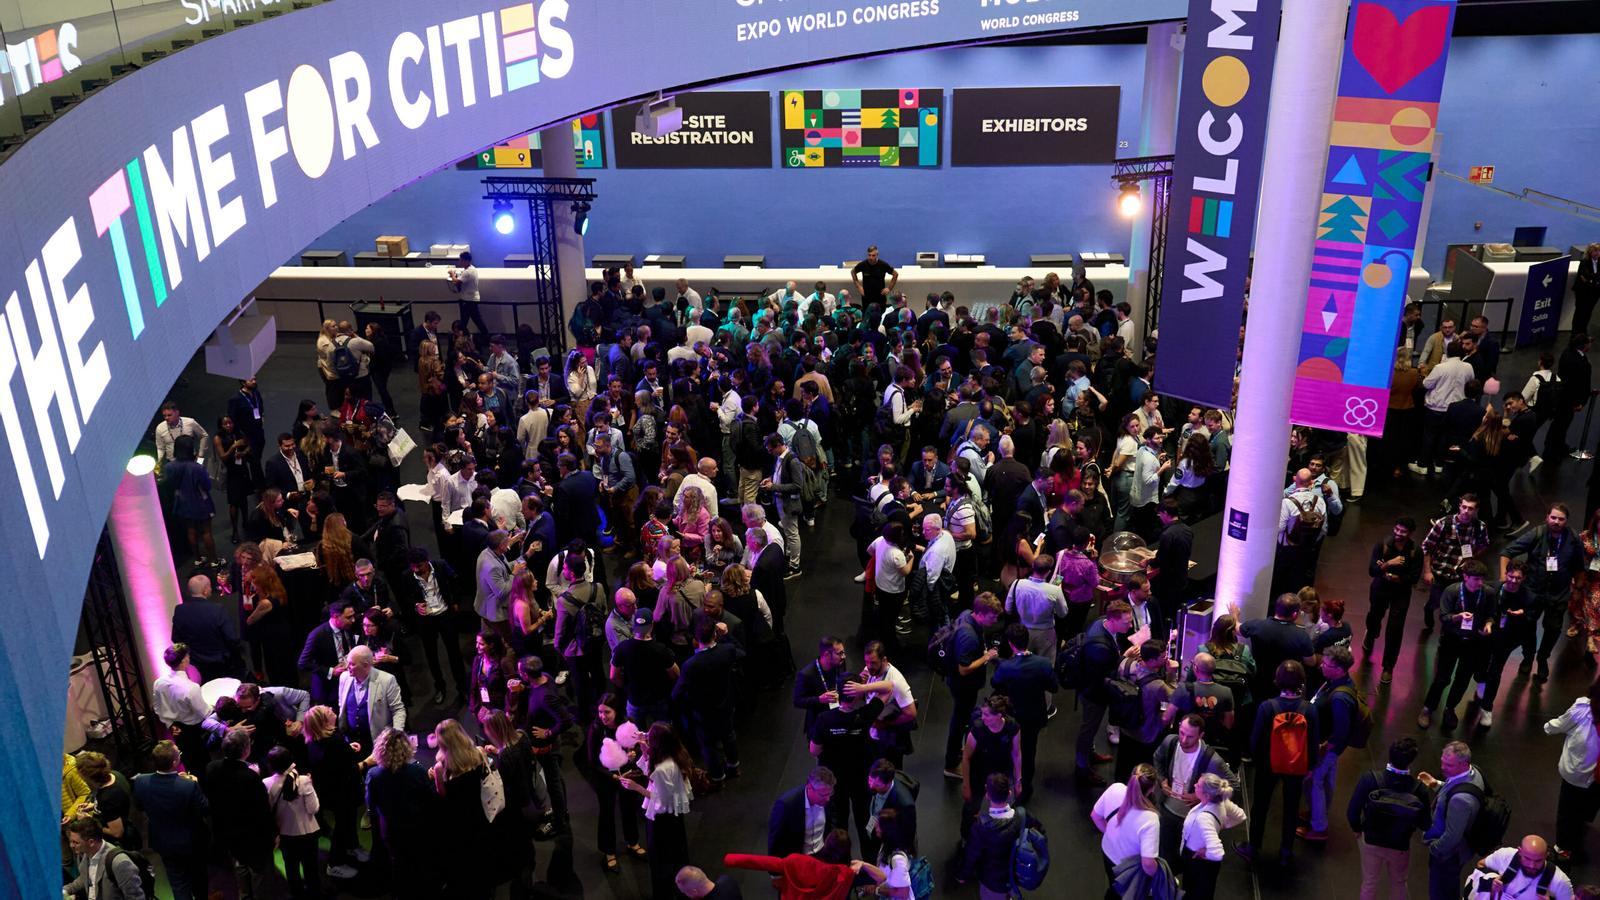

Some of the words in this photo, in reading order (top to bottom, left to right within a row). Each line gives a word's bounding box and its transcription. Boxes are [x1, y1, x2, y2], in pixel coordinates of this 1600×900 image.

[736, 18, 782, 42] EXPO
[786, 10, 847, 34] WORLD
[852, 0, 940, 25] CONGRESS
[980, 16, 1020, 31] WORLD
[1022, 10, 1080, 26] CONGRESS
[682, 115, 726, 129] -SITE
[982, 117, 1088, 133] EXHIBITORS
[1119, 140, 1129, 148] 23
[89, 103, 248, 341] TIME
[243, 50, 380, 210] FOR
[388, 0, 576, 130] CITIES
[1534, 297, 1552, 311] Exit
